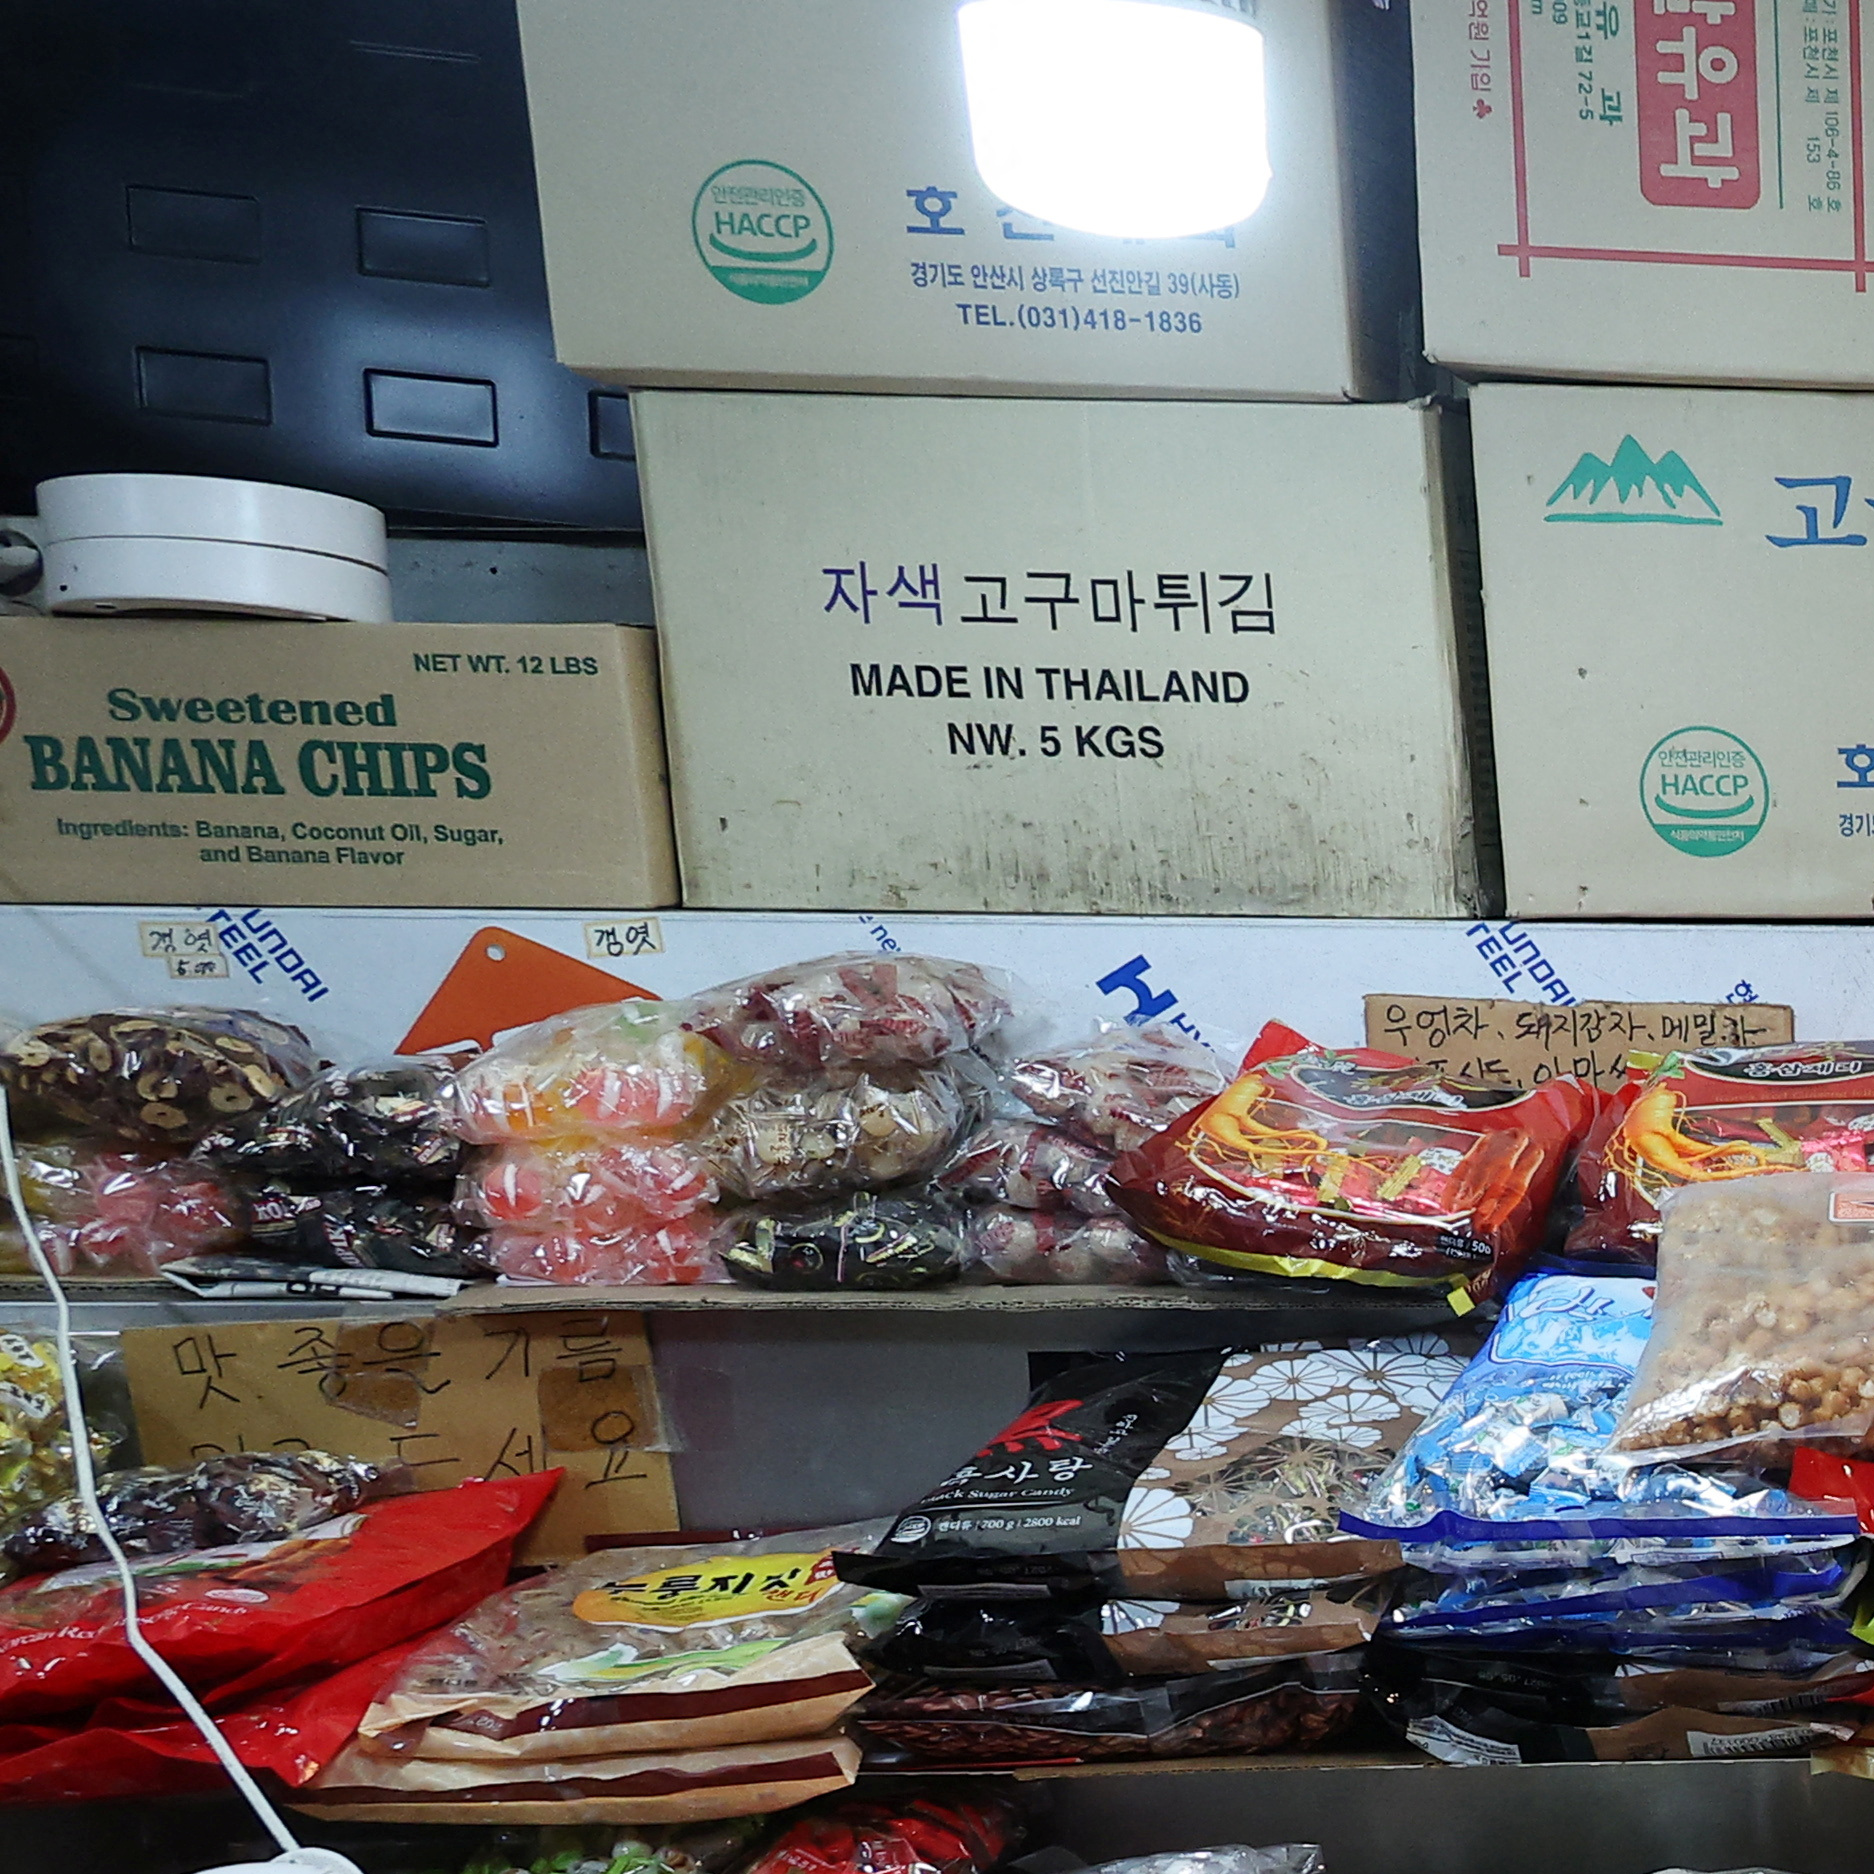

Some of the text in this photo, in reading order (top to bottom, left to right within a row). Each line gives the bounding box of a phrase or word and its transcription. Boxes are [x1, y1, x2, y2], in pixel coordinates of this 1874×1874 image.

[713, 209, 811, 240] HACCP
[909, 260, 1241, 300] 경기도 안산시 상록구 선진안길 39(사동)
[412, 651, 600, 677] NET WT. 12 LBS
[849, 662, 1250, 705] MADE IN THAILAND
[107, 686, 398, 729] Sweetened
[946, 721, 1166, 760] NW. 5 KGS
[22, 734, 494, 801] BANANA CHIPS
[1661, 772, 1749, 799] HACCP
[56, 817, 505, 848] Ingredients: Banana, Coconut Oil, Sugar,
[198, 843, 405, 868] and Banana Flavor
